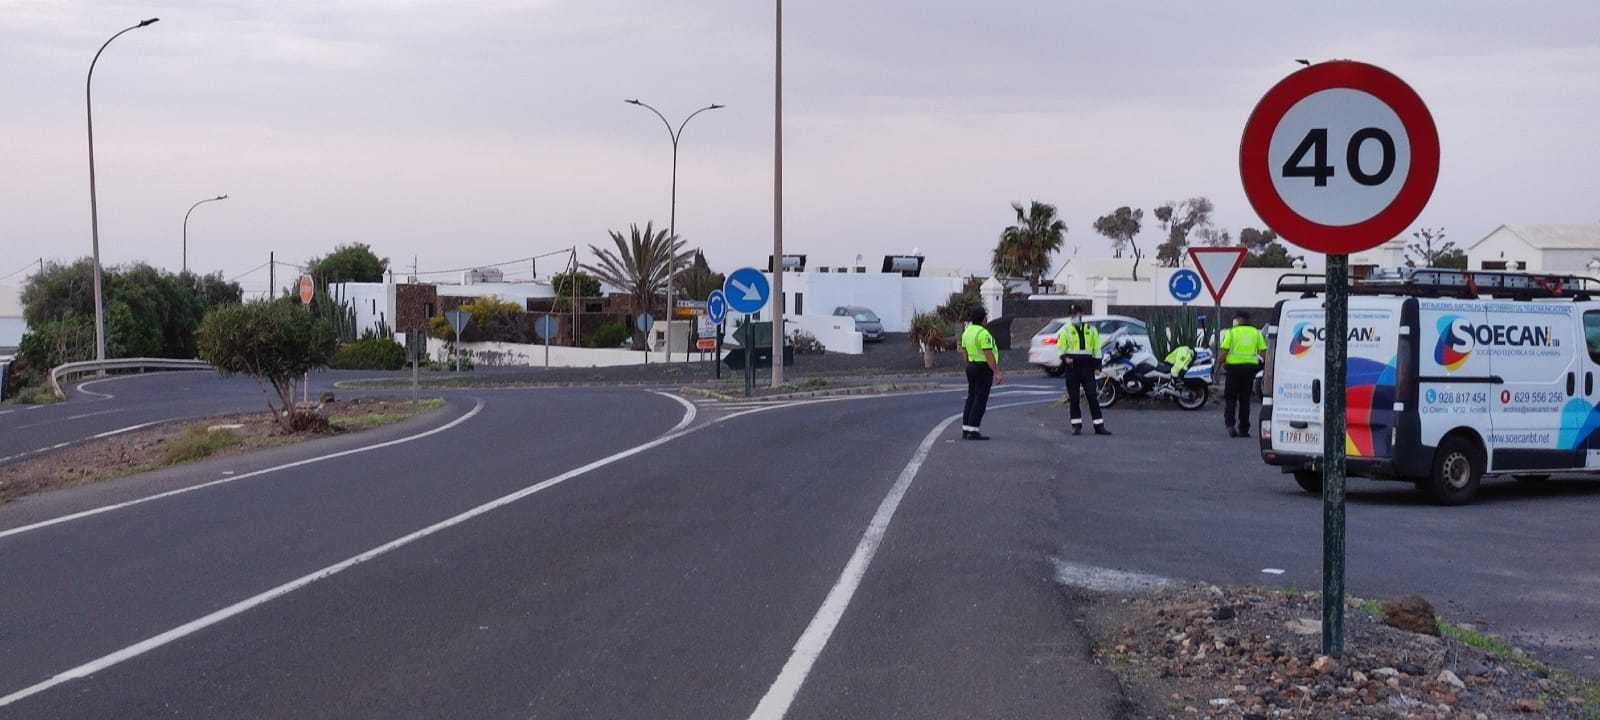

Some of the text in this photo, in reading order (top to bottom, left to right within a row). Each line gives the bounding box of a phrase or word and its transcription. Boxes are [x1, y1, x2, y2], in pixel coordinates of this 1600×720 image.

[1282, 127, 1397, 187] 40
[1451, 318, 1548, 353] SOECAN
[1438, 392, 1486, 404] 928 817 454
[1514, 391, 1530, 403] 629
[1548, 391, 1563, 403] 256
[1285, 432, 1301, 442] 1781
[1487, 432, 1550, 444] www.soecanbt.net
